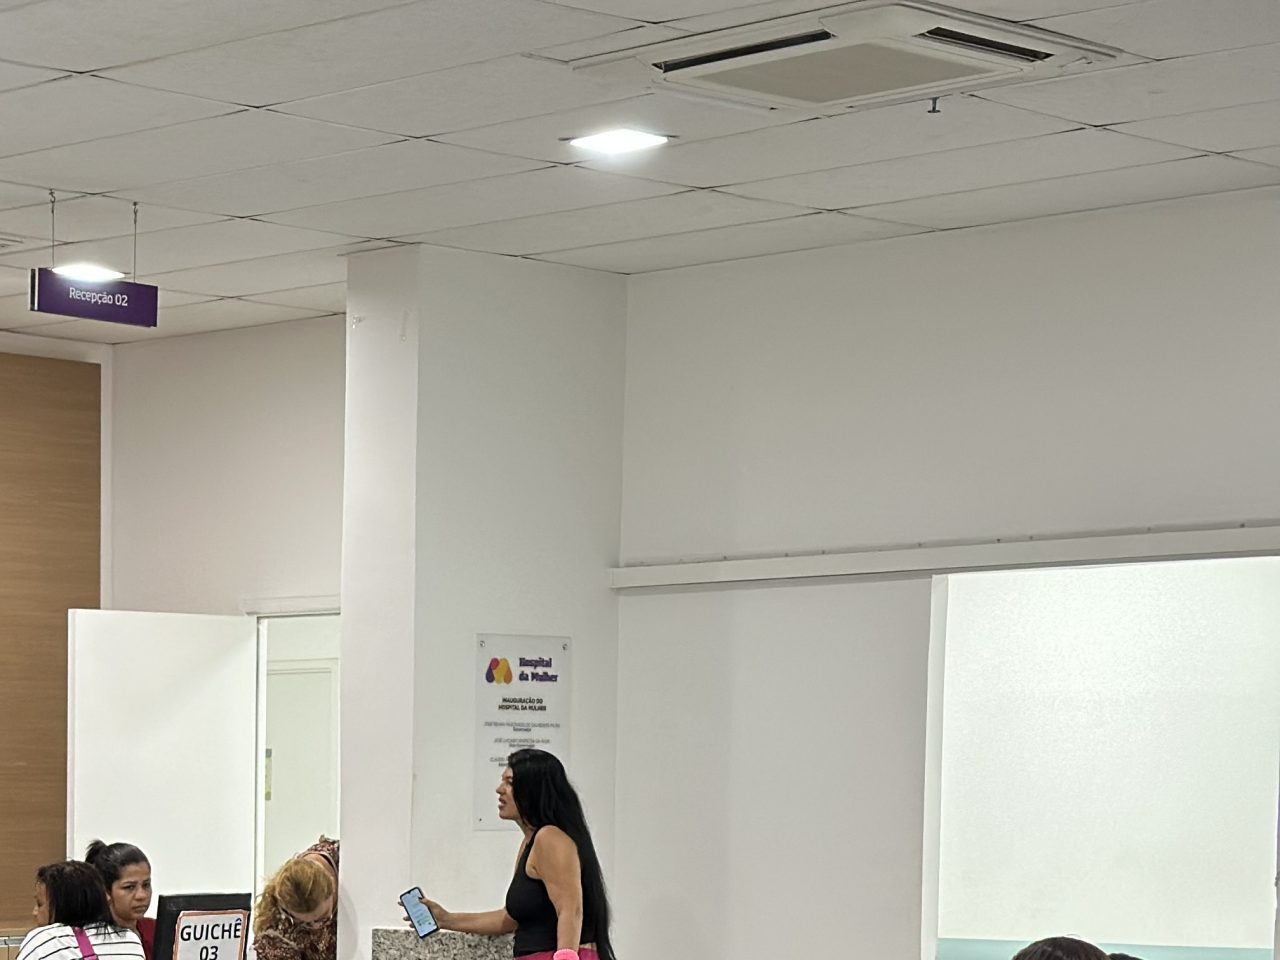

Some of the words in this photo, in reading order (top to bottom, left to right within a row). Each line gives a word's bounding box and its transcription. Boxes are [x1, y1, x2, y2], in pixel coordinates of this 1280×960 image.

[69, 287, 113, 305] Recepção
[115, 294, 128, 306] 02
[519, 657, 552, 669] Hospital
[519, 671, 529, 681] da
[531, 671, 558, 682] Mulher
[180, 917, 242, 942] GUICHÊ
